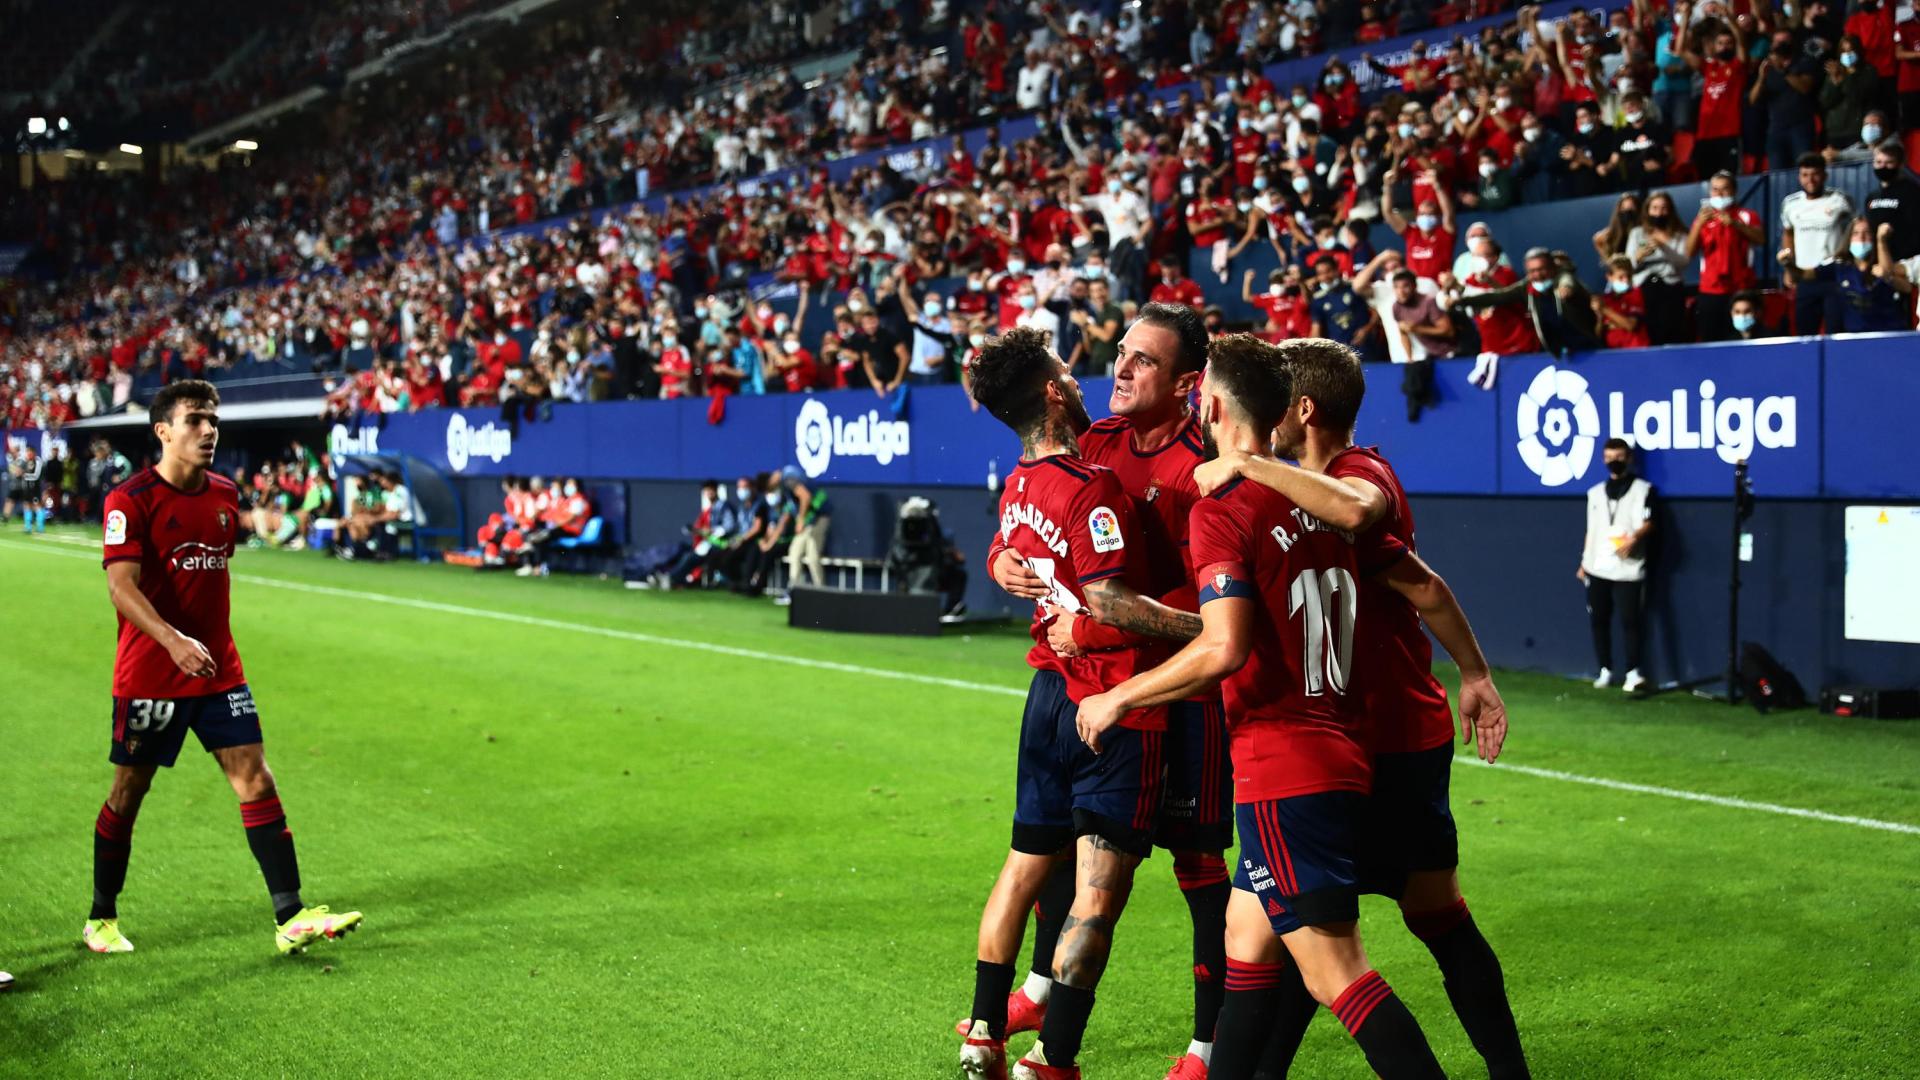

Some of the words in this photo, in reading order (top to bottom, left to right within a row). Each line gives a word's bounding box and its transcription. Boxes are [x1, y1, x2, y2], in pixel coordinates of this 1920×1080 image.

[833, 409, 910, 465] LaLiga
[1609, 379, 1797, 465] LaLiga
[1097, 537, 1120, 547] LaLiga
[1270, 525, 1299, 553] R.
[1288, 567, 1357, 697] 10
[128, 698, 175, 732] 39
